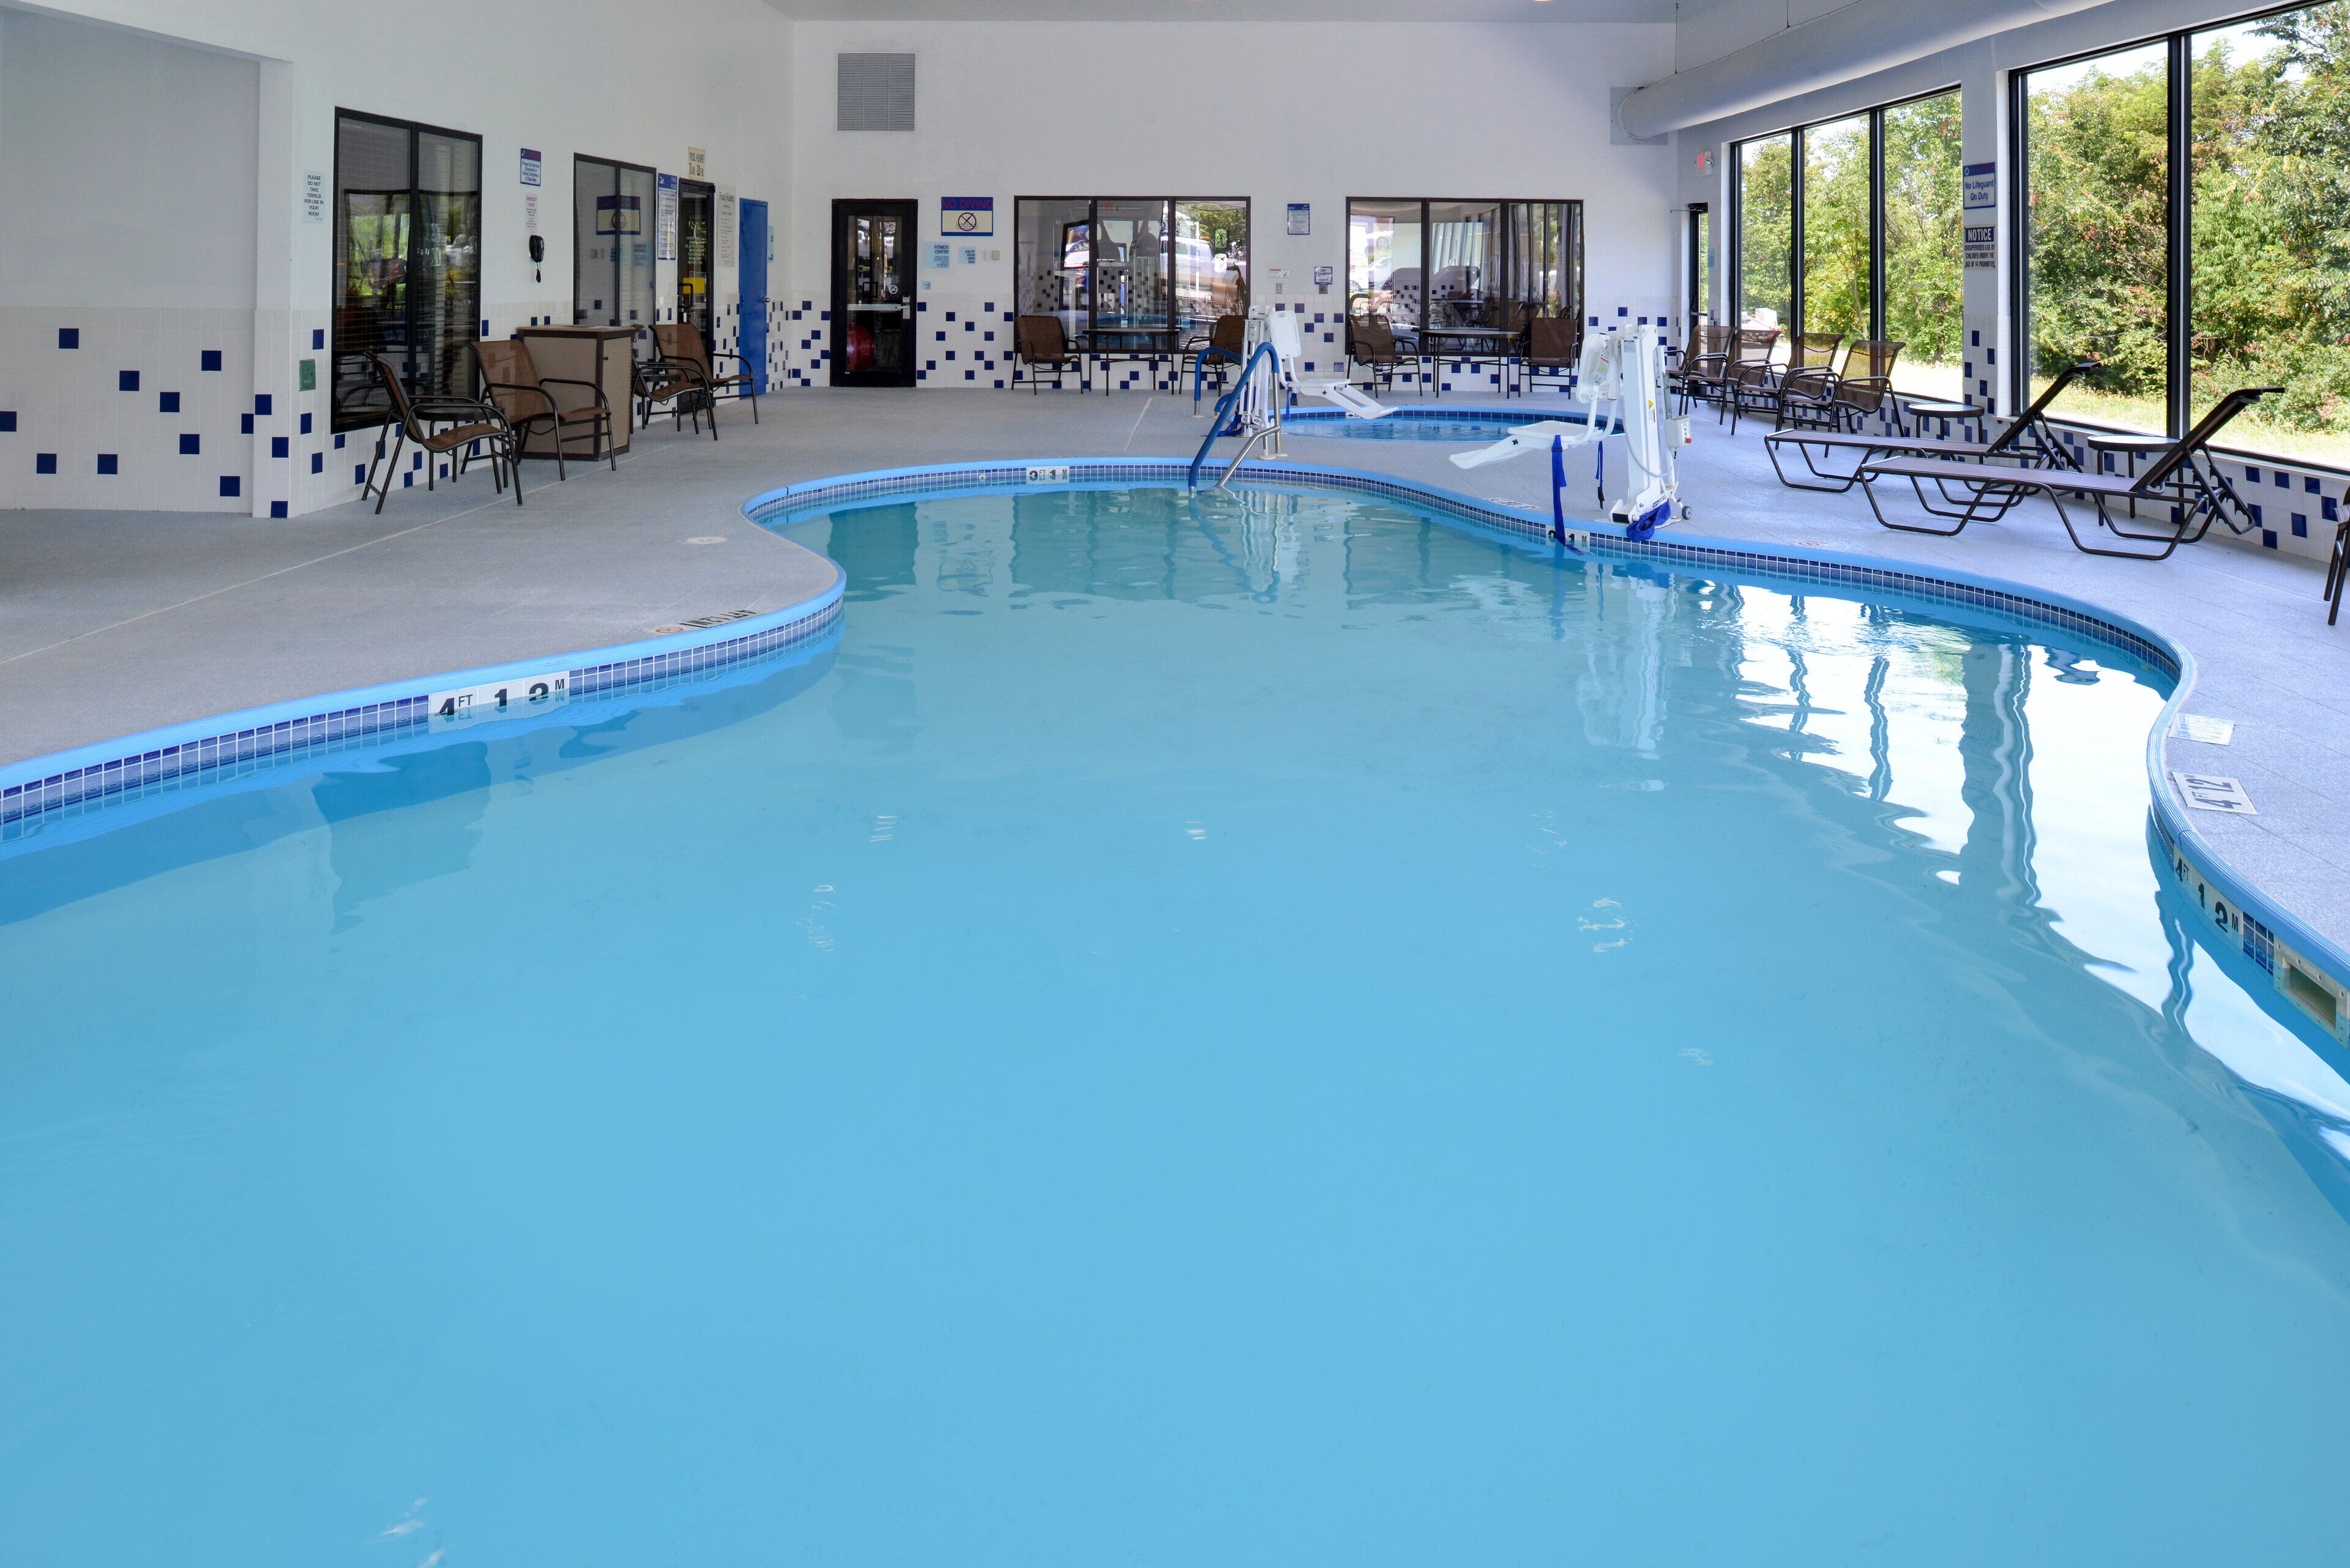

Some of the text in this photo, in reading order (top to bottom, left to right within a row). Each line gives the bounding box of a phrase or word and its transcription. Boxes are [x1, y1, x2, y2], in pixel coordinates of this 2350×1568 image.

[1972, 179, 1994, 190] Lifeguard
[1978, 192, 1988, 201] Duty
[942, 199, 993, 209] NO DIVING
[1968, 228, 1991, 241] NOTICE
